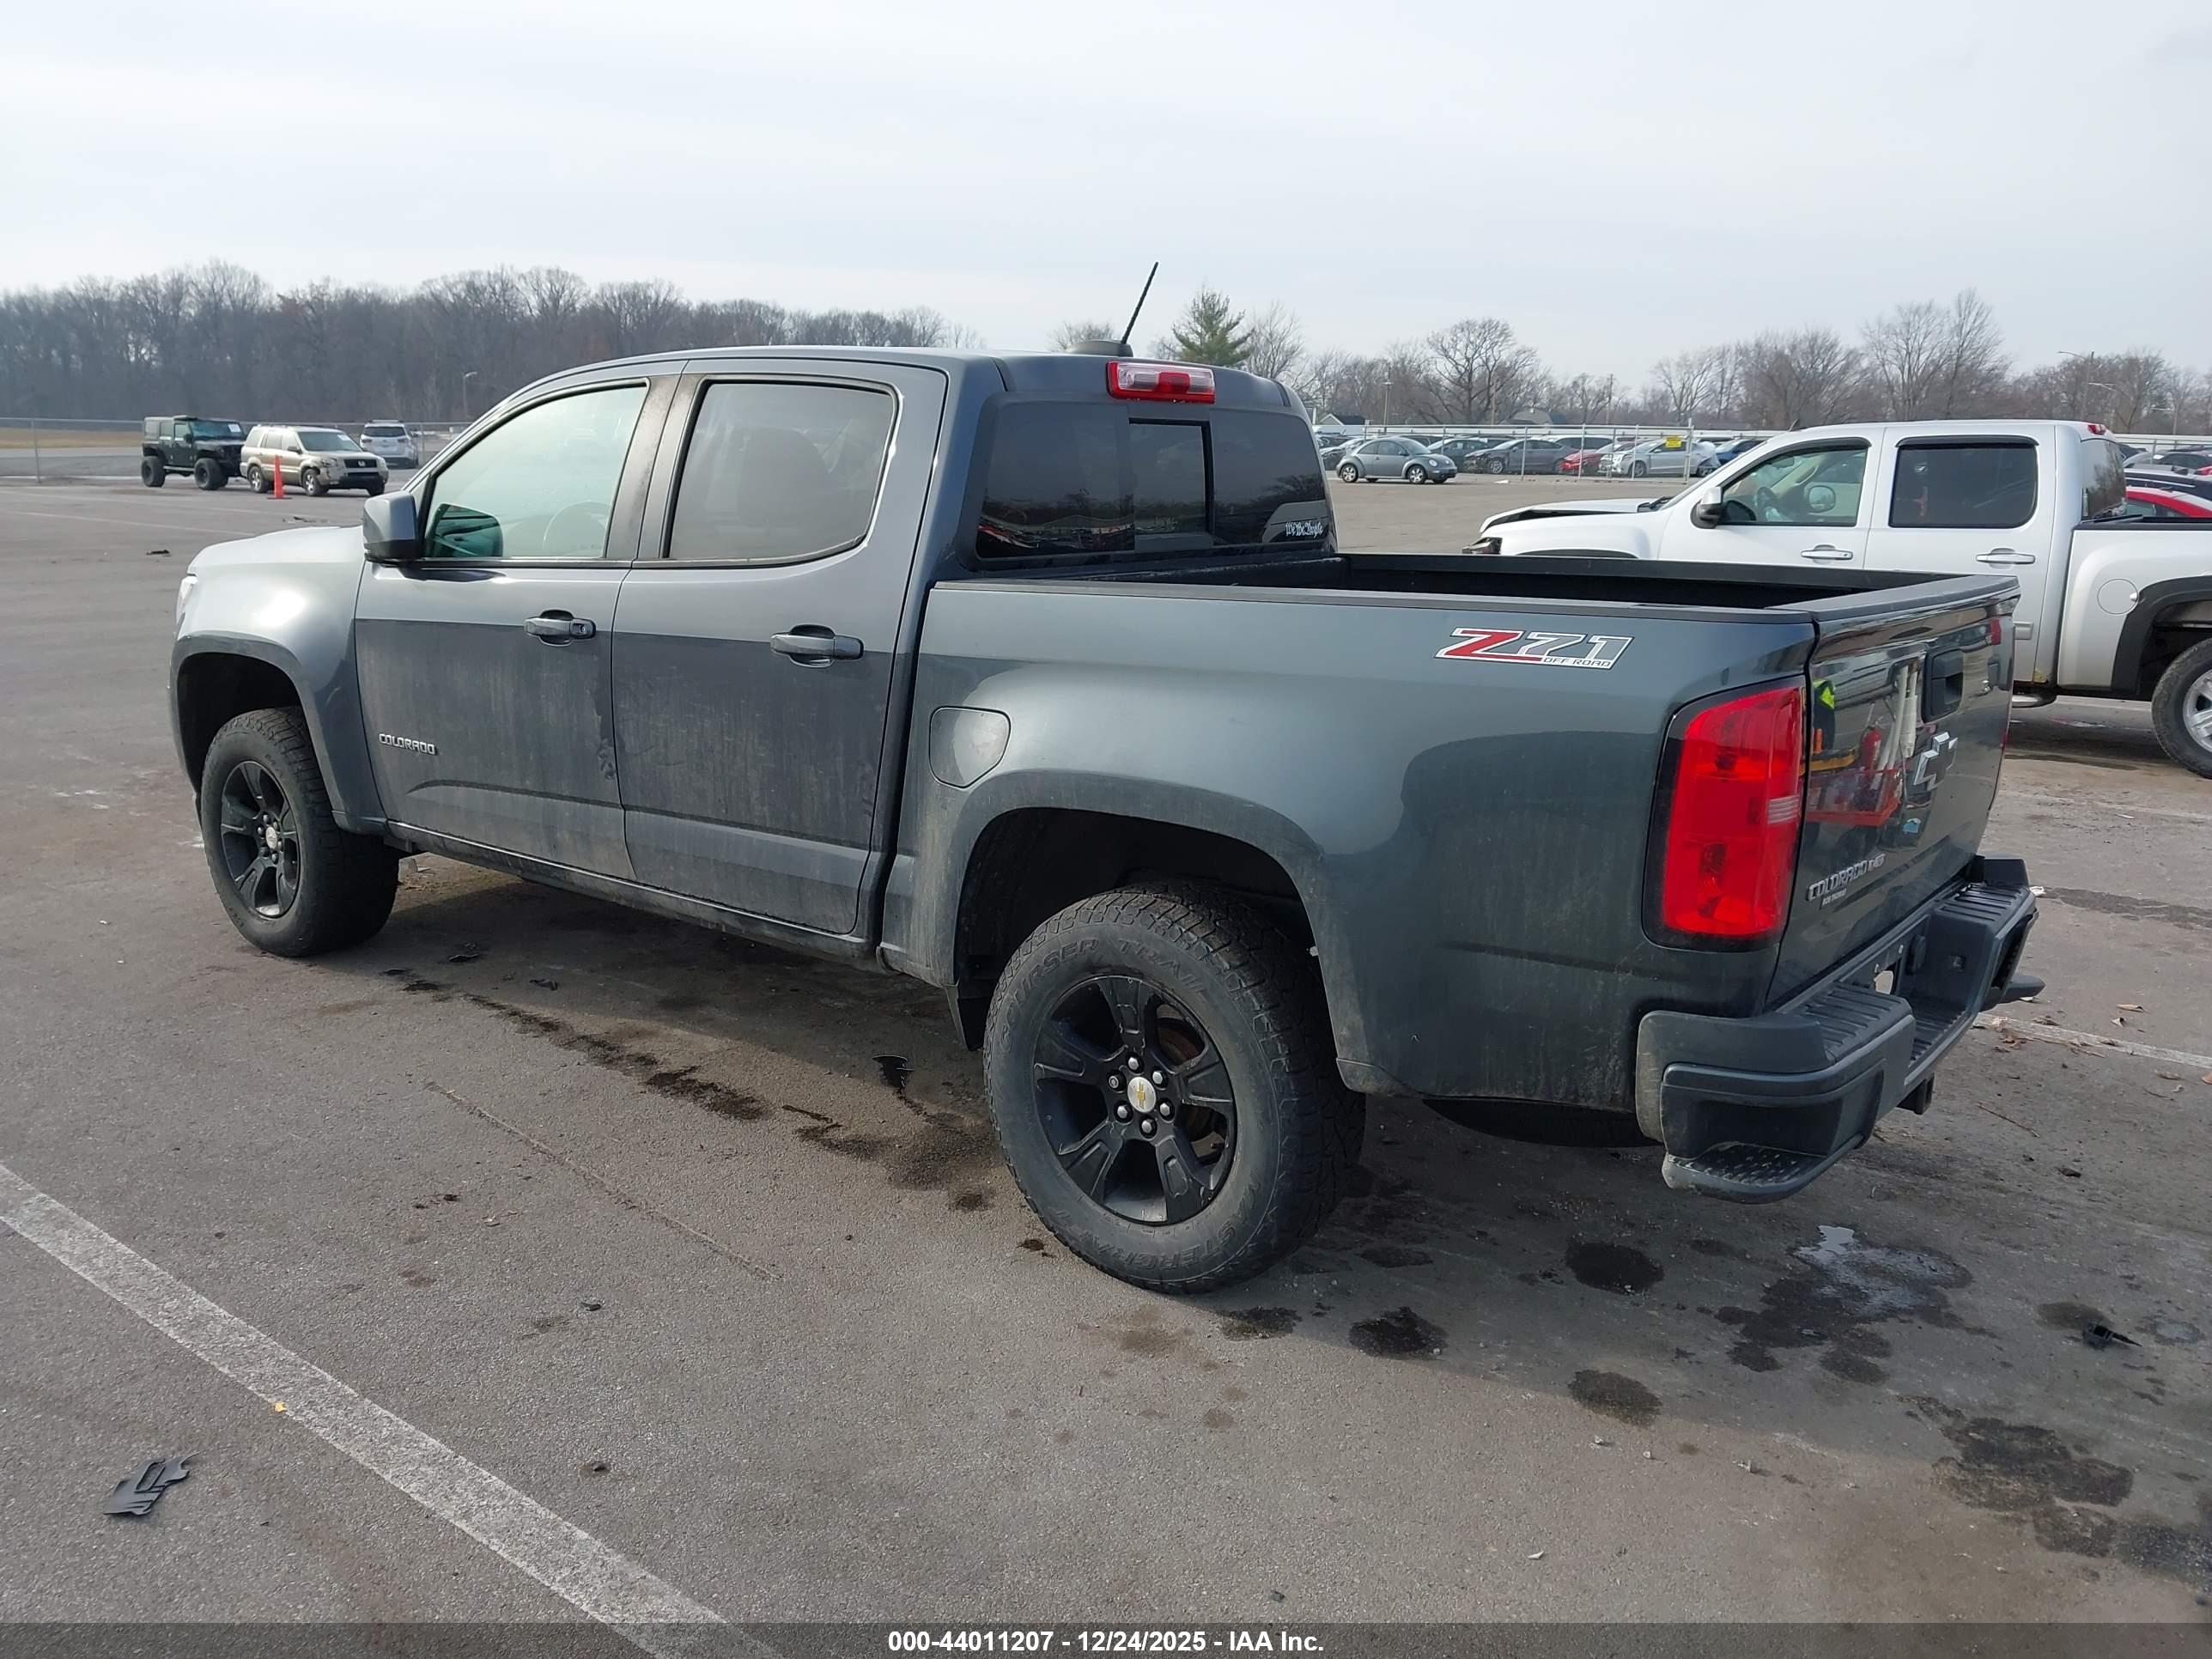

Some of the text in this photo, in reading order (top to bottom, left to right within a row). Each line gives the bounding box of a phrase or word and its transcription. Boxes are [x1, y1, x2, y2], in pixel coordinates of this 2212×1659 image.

[1433, 626, 1636, 671] Z71
[1543, 656, 1611, 668] OFF ROAD
[379, 732, 435, 756] COLORADO
[1808, 859, 1868, 903] COLORADO
